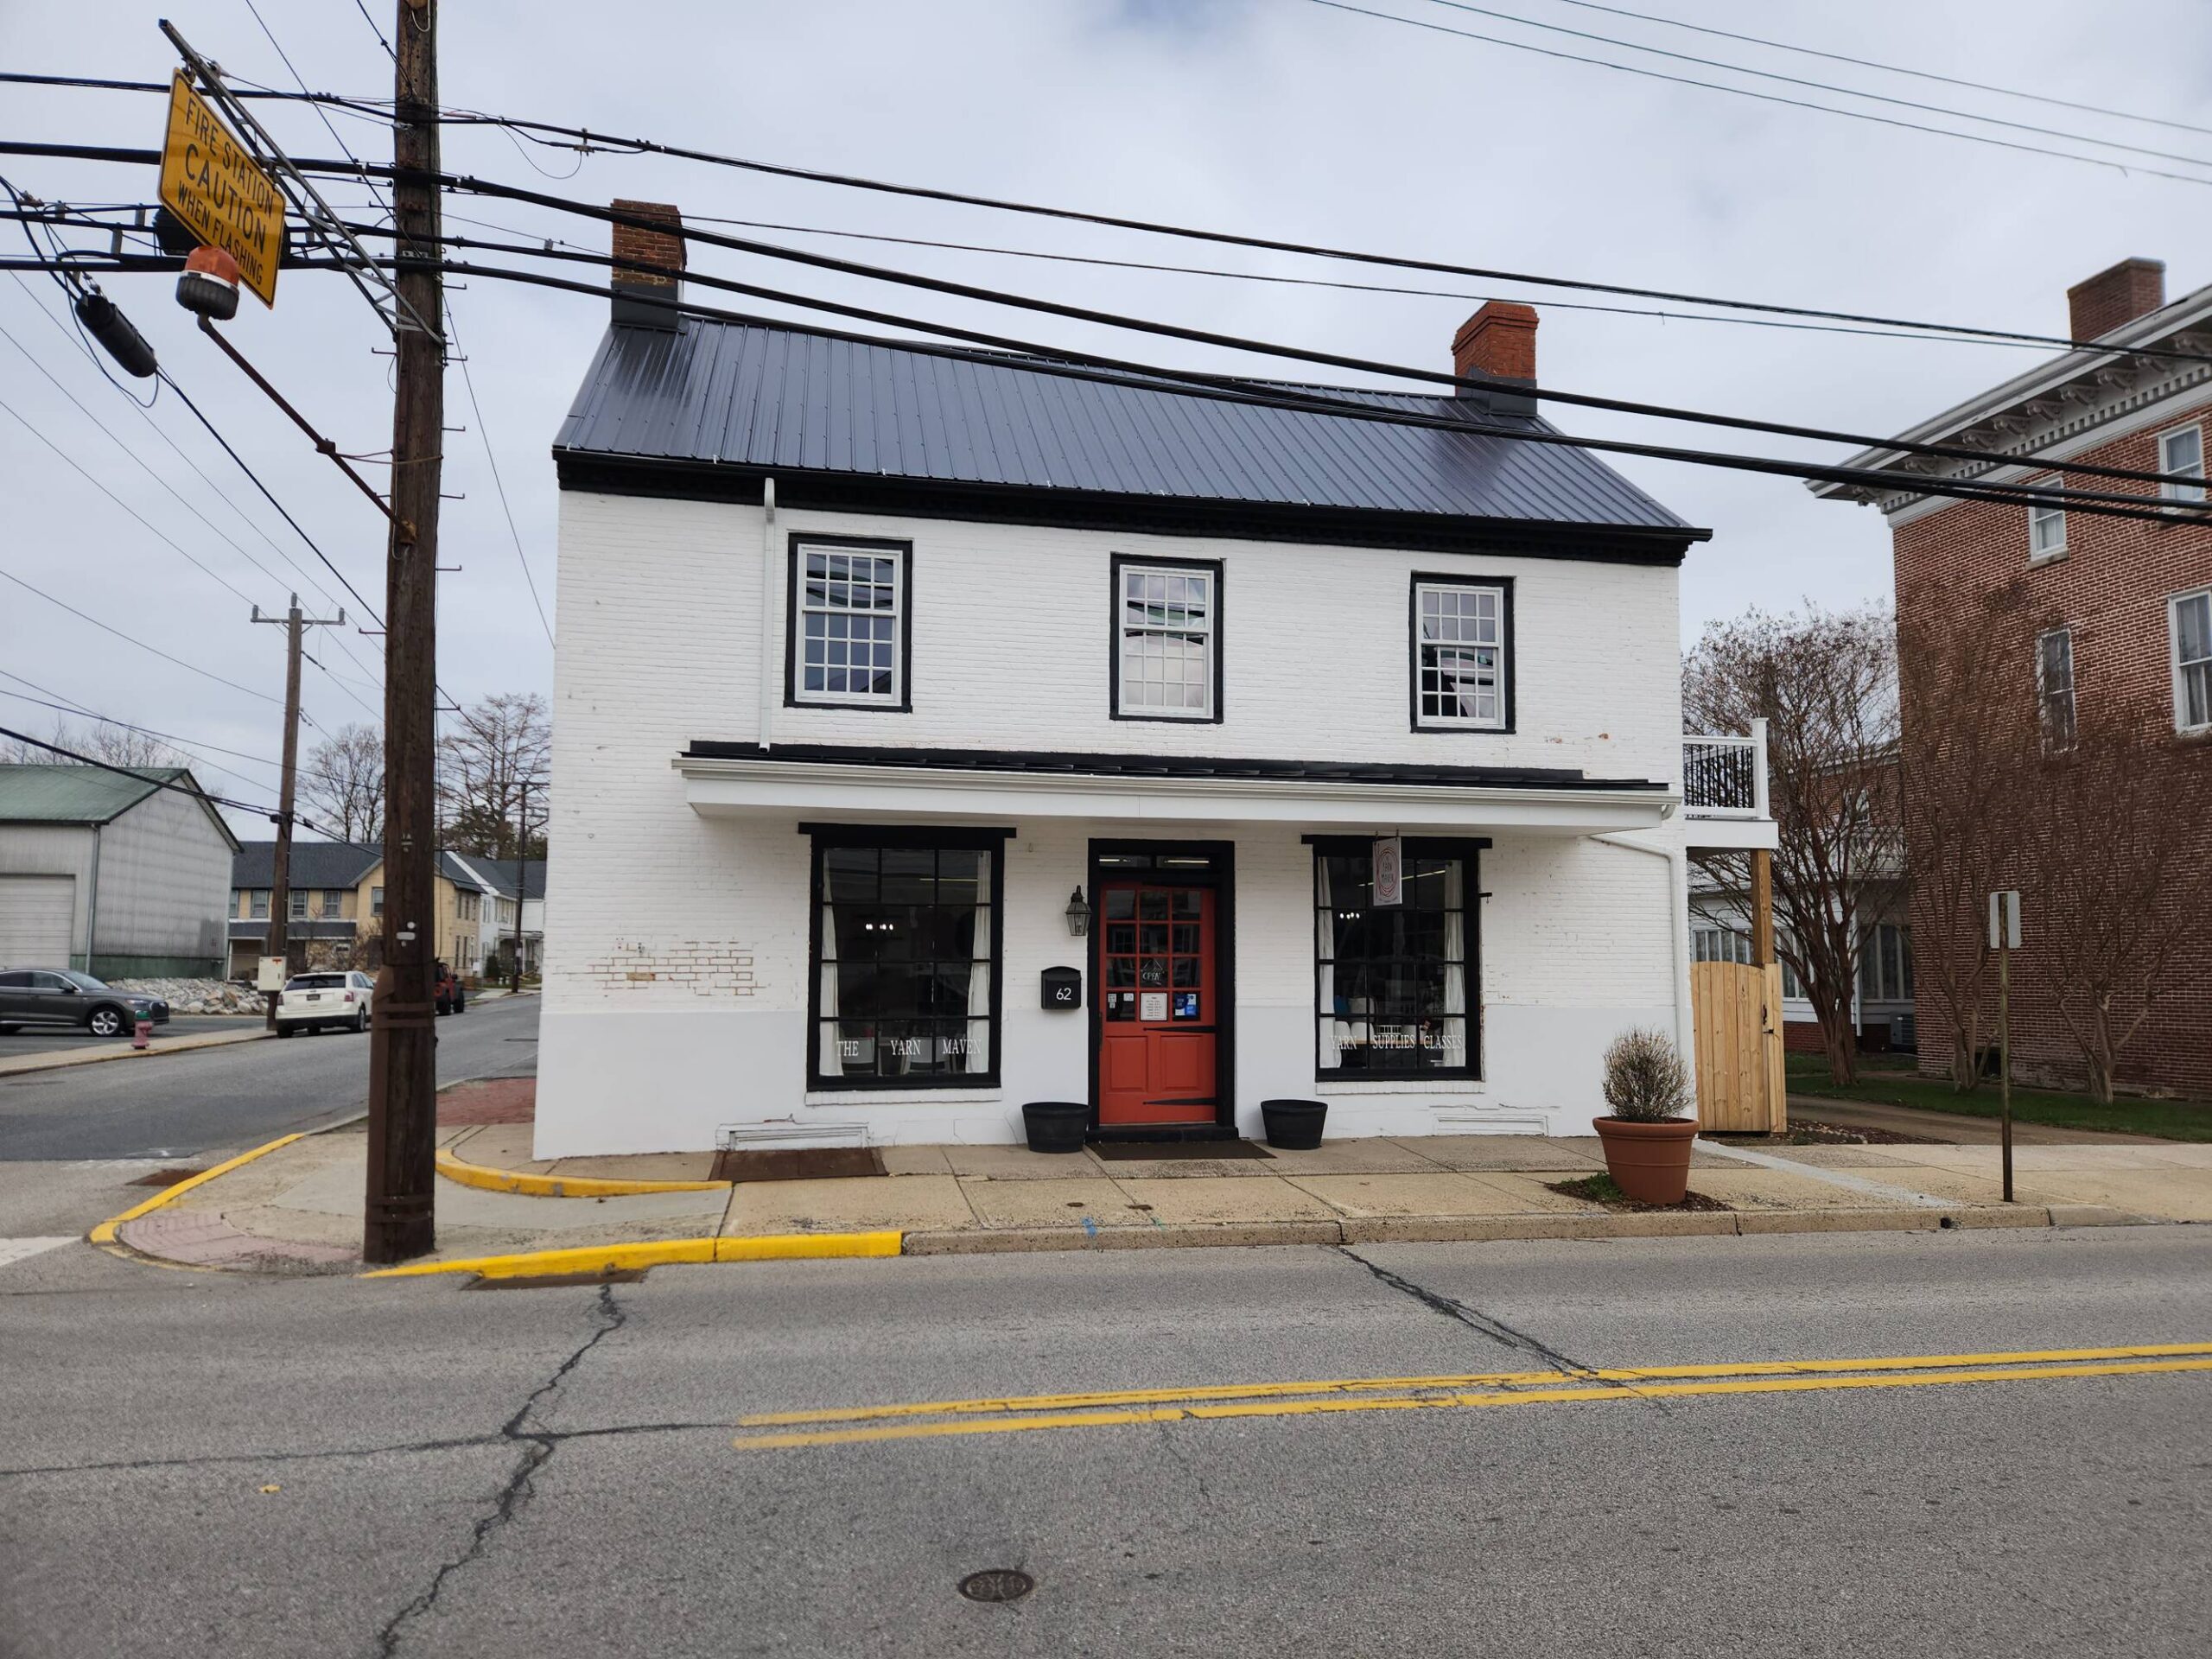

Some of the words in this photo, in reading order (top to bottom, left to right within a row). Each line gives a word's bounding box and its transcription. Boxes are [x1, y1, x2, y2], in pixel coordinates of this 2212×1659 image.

[186, 96, 219, 156] FIRE
[222, 141, 273, 218] STATION
[185, 143, 266, 256] CAUTION
[178, 180, 210, 232] WHEN
[213, 220, 263, 286] FLASHING
[1056, 988, 1071, 1001] 62
[836, 1040, 859, 1057] THE
[891, 1039, 921, 1056] YARN
[943, 1039, 982, 1054] MAVEN
[1330, 1035, 1357, 1050] YARN
[1372, 1034, 1415, 1049] SUPPLIES
[1423, 1035, 1462, 1049] CLASSES
